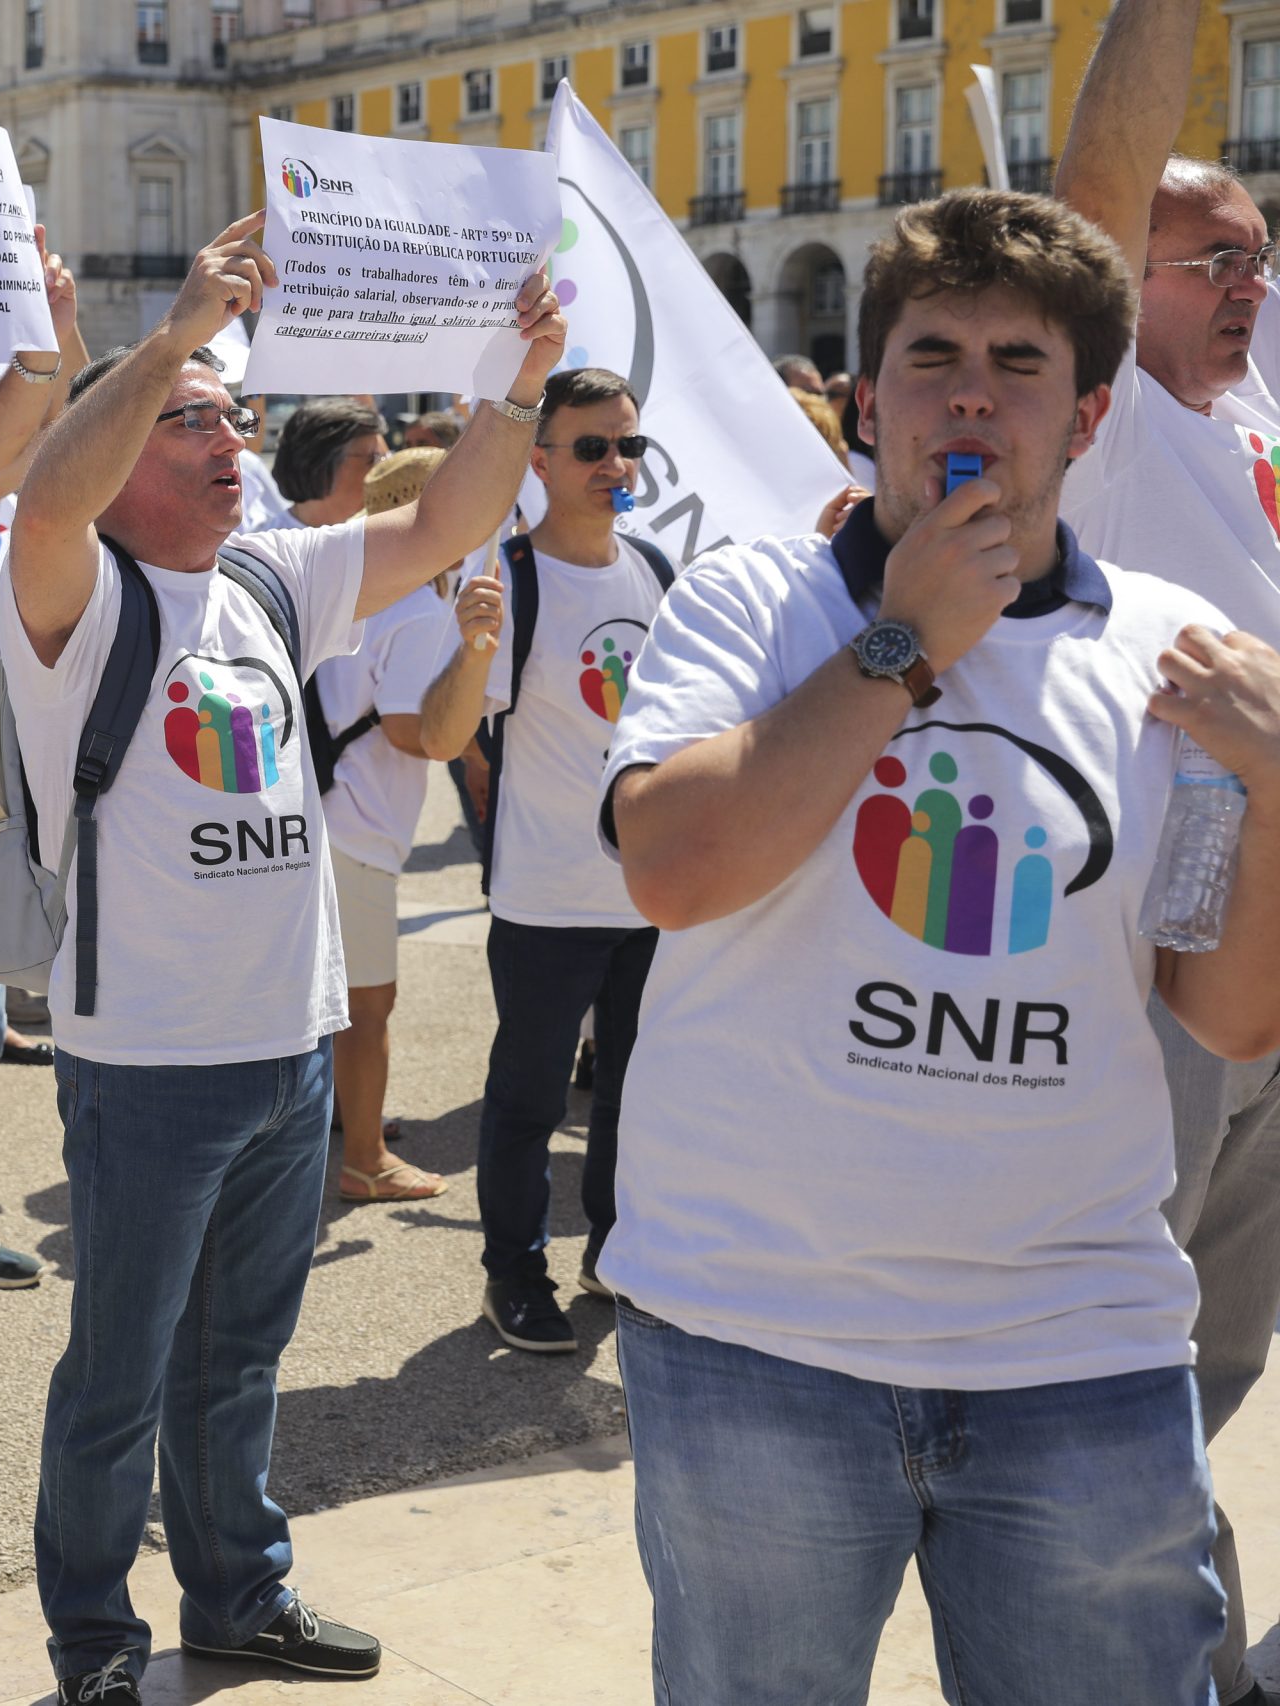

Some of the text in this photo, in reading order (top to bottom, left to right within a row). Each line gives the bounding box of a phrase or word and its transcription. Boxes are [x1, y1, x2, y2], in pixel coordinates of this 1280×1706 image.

[320, 178, 354, 193] SNR
[4, 230, 13, 241] DO
[301, 210, 362, 228] PRINCÍPIO
[366, 217, 382, 230] DA
[384, 219, 450, 238] IGUALDADE
[516, 232, 534, 244] DA
[292, 230, 380, 252] CONSTITUIÇÃO
[384, 240, 400, 254] DA
[403, 242, 464, 260] REPÚBLICA
[284, 260, 326, 276] (Todos
[338, 266, 352, 277] os
[362, 266, 438, 284] trabalhadores
[448, 274, 469, 288] têm
[480, 280, 486, 288] o
[283, 283, 350, 300] retribuição
[354, 288, 397, 304] salarial,
[402, 291, 478, 308] observando-se
[482, 301, 488, 309] o
[282, 302, 296, 314] de
[302, 306, 324, 320] que
[328, 310, 354, 321] para
[359, 310, 405, 324] trabalho
[442, 316, 476, 326] salário
[276, 324, 428, 344] categorias e carreiras iguais)
[634, 435, 736, 564] SN
[190, 814, 310, 866] SNR
[194, 860, 310, 880] Sindicato Nacional dos Registos
[848, 981, 1070, 1065] SNR
[846, 1052, 1065, 1090] Sindicato Nacional dos Registos
